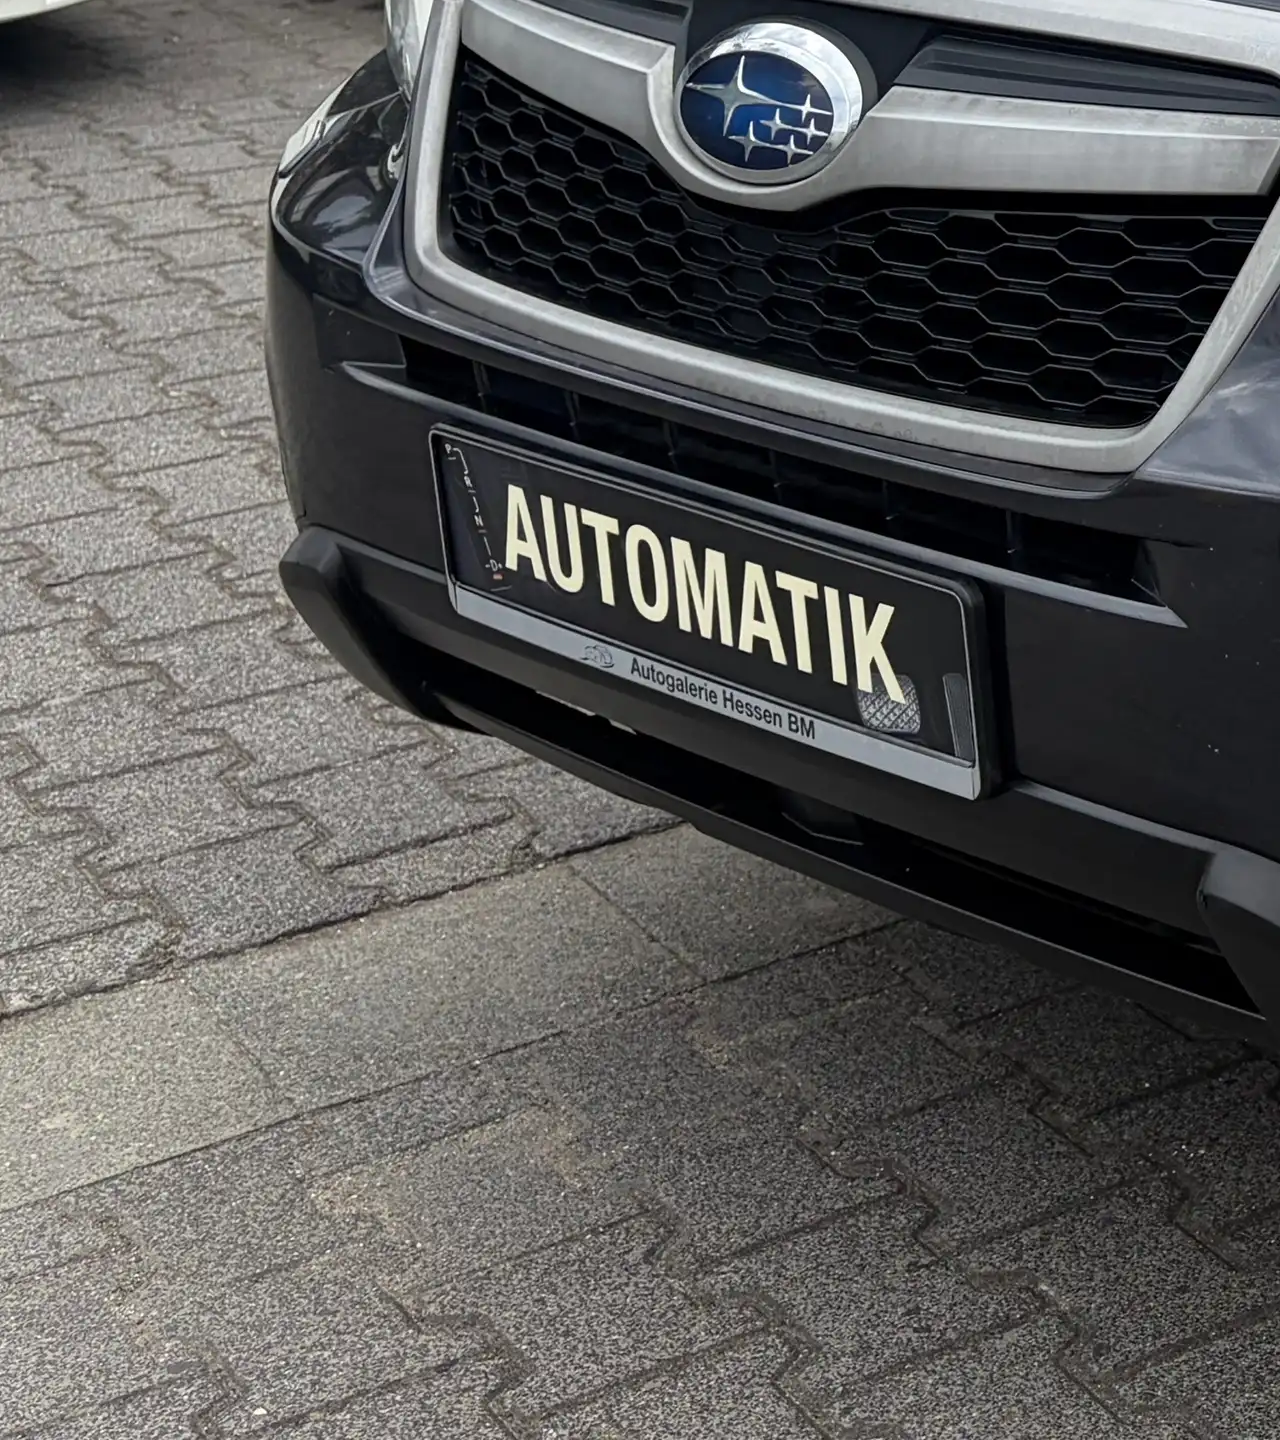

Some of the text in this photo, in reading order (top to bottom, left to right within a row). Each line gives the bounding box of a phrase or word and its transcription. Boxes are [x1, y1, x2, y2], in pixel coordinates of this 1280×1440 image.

[505, 483, 906, 705] AUTOMATIK
[631, 657, 816, 740] Autogalerie Hessen BM
